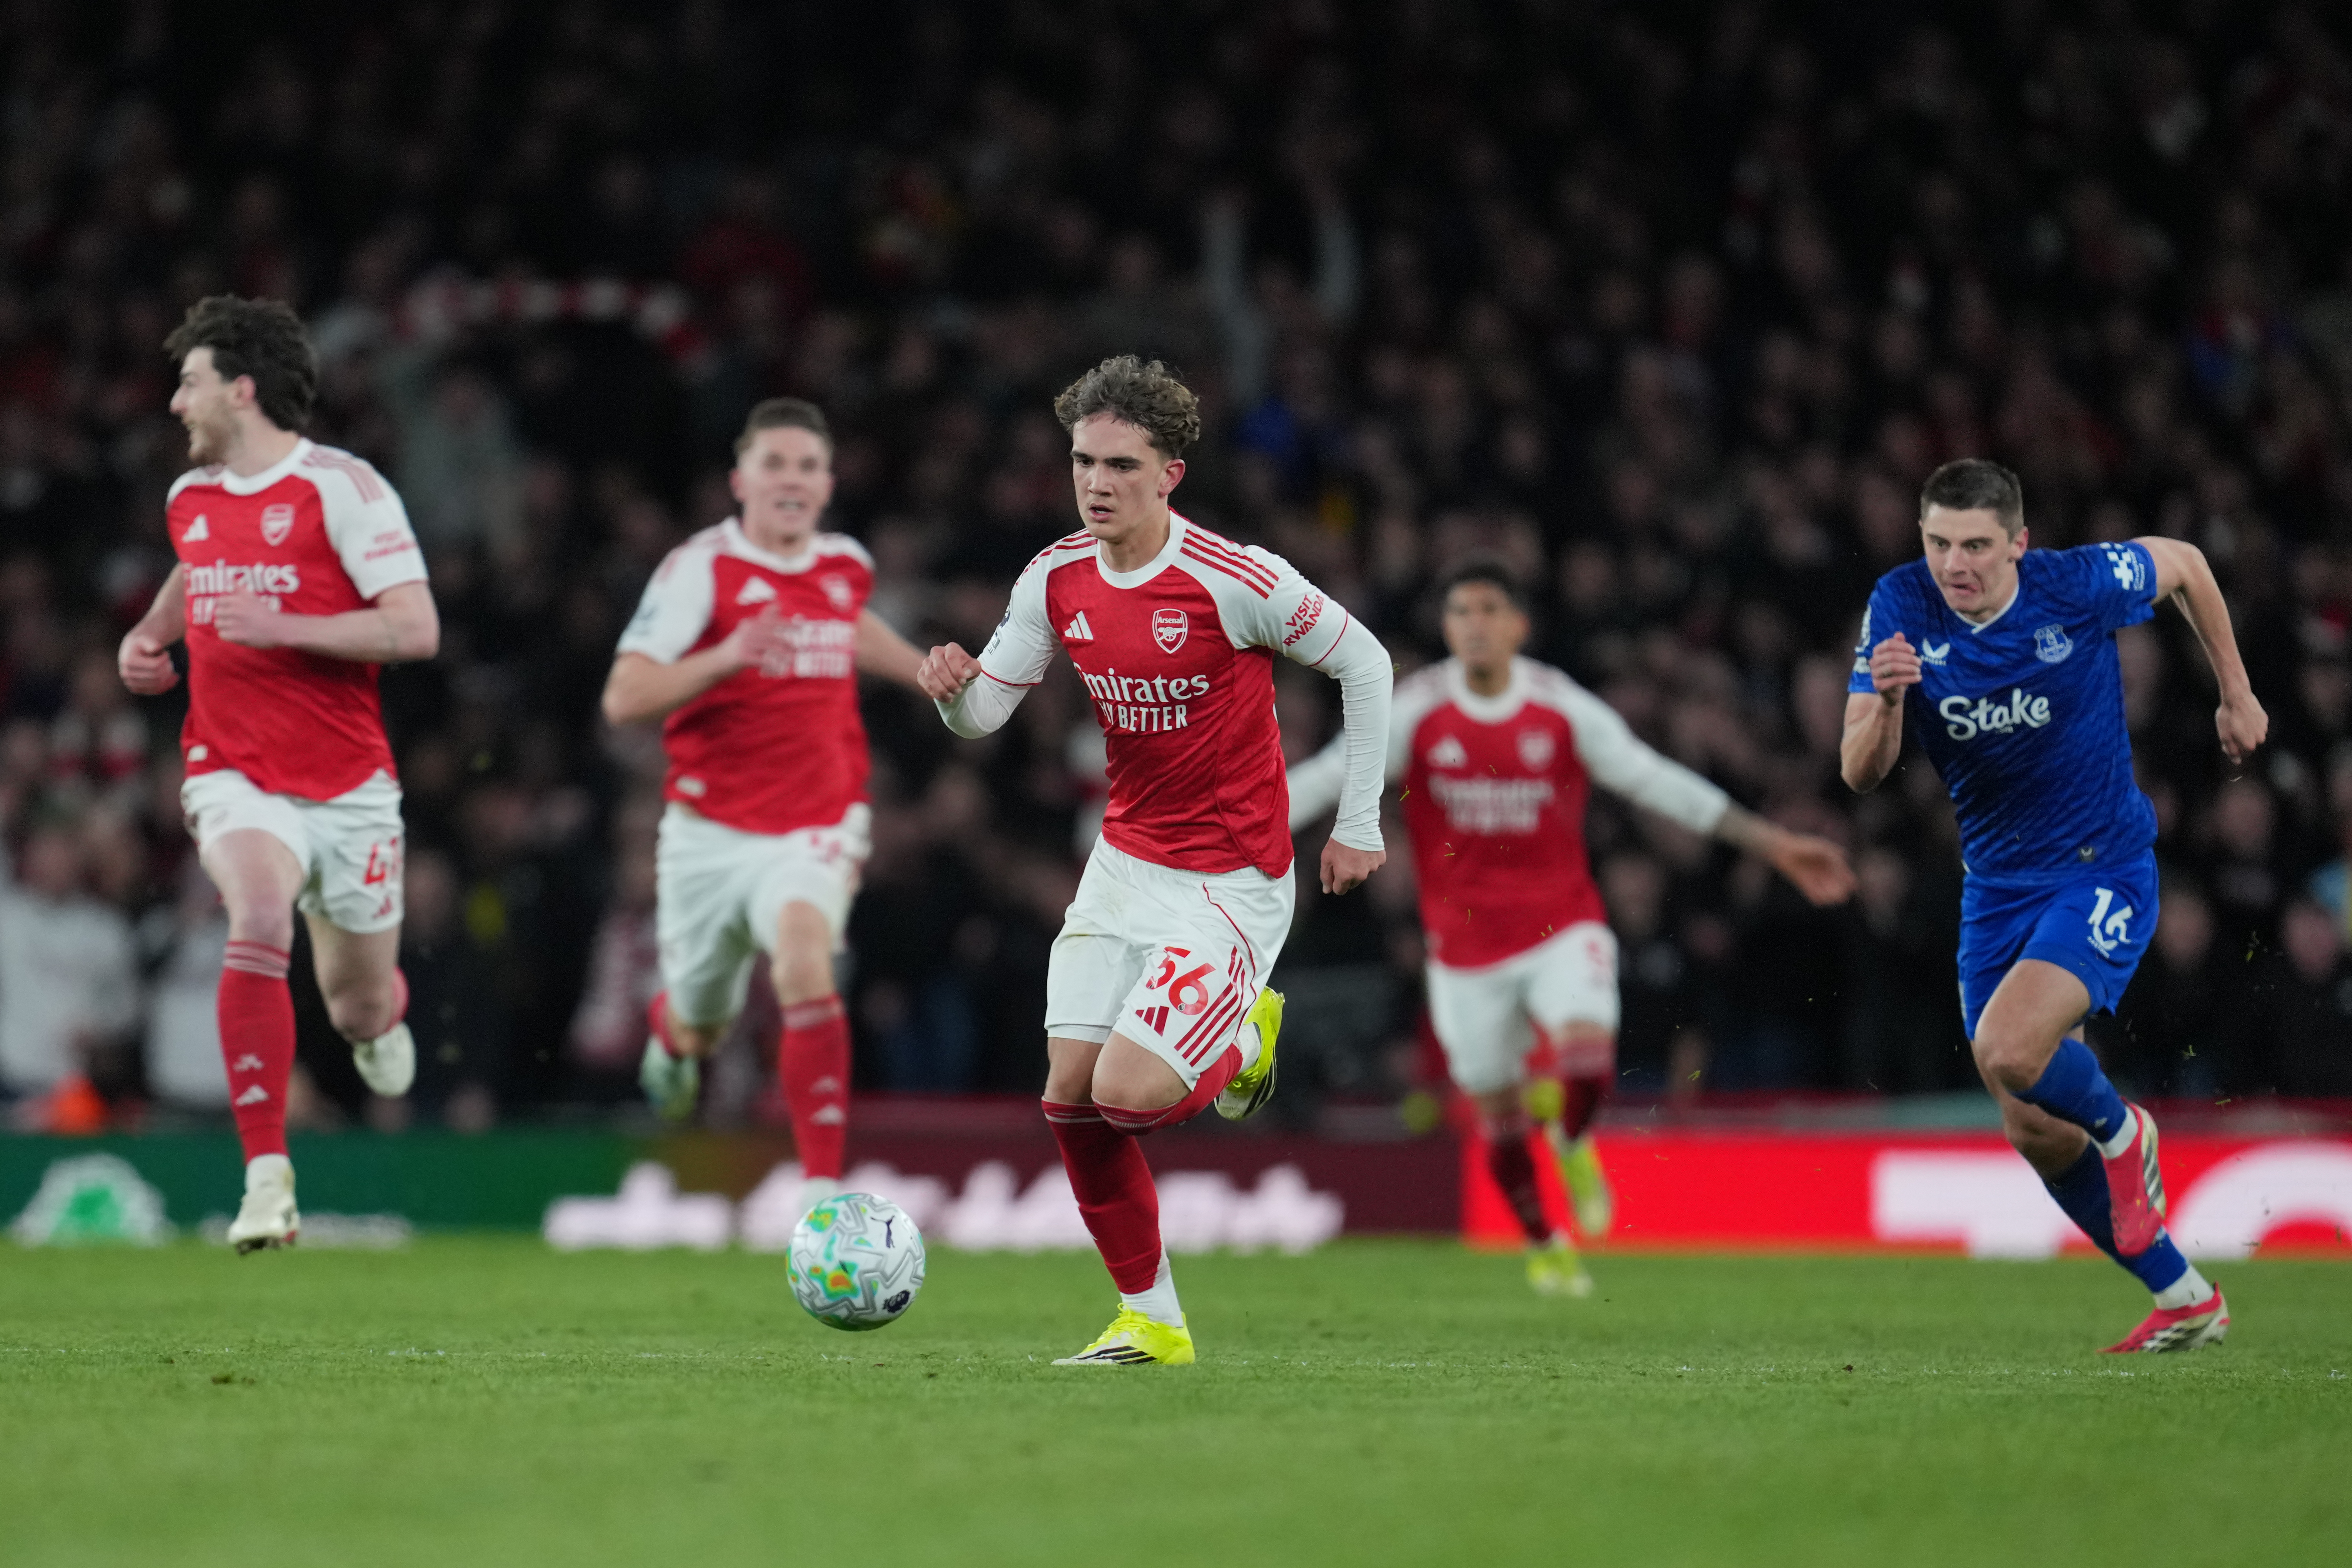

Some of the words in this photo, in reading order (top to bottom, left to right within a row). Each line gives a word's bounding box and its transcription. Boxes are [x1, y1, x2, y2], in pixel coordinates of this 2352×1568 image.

[1283, 595, 1324, 647] RWANDA
[1285, 594, 1312, 627] VISIT
[1118, 704, 1188, 732] BETTER
[1939, 688, 2051, 741] Stake
[2087, 886, 2133, 951] 16
[1146, 946, 1216, 1015] 56
